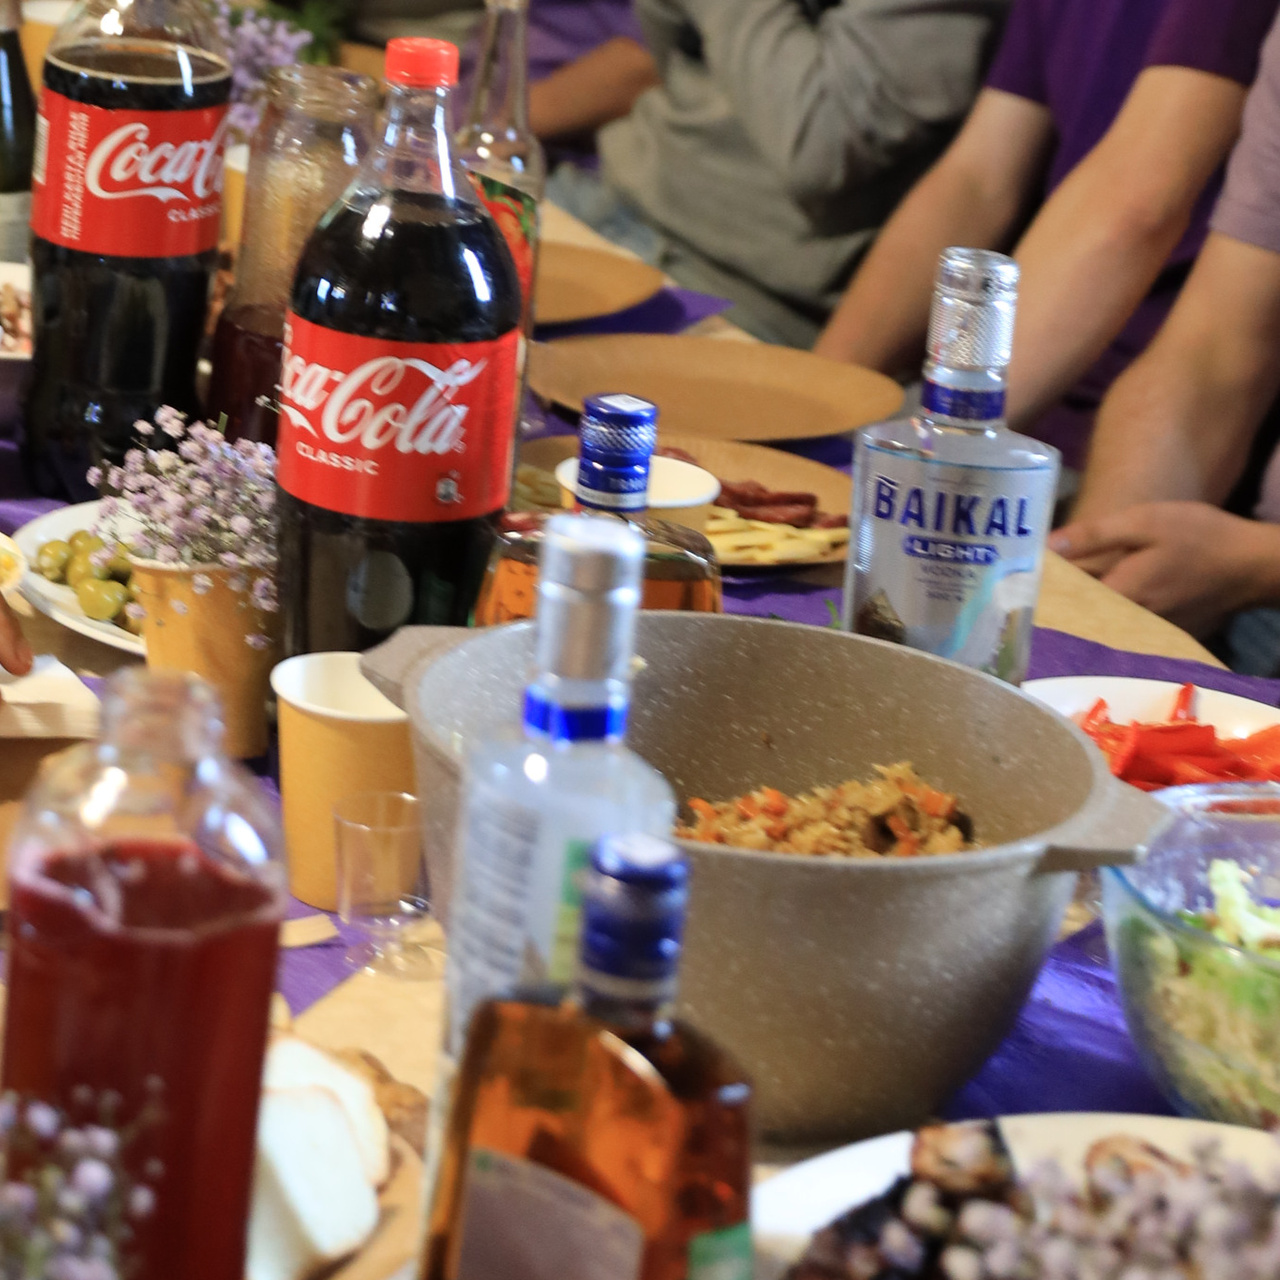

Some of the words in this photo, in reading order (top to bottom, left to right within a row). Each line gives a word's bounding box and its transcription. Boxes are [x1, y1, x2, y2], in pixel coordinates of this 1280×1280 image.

[296, 441, 380, 476] CLASSIC
[874, 475, 1032, 537] BAIKAL
[911, 537, 990, 563] LIGHT
